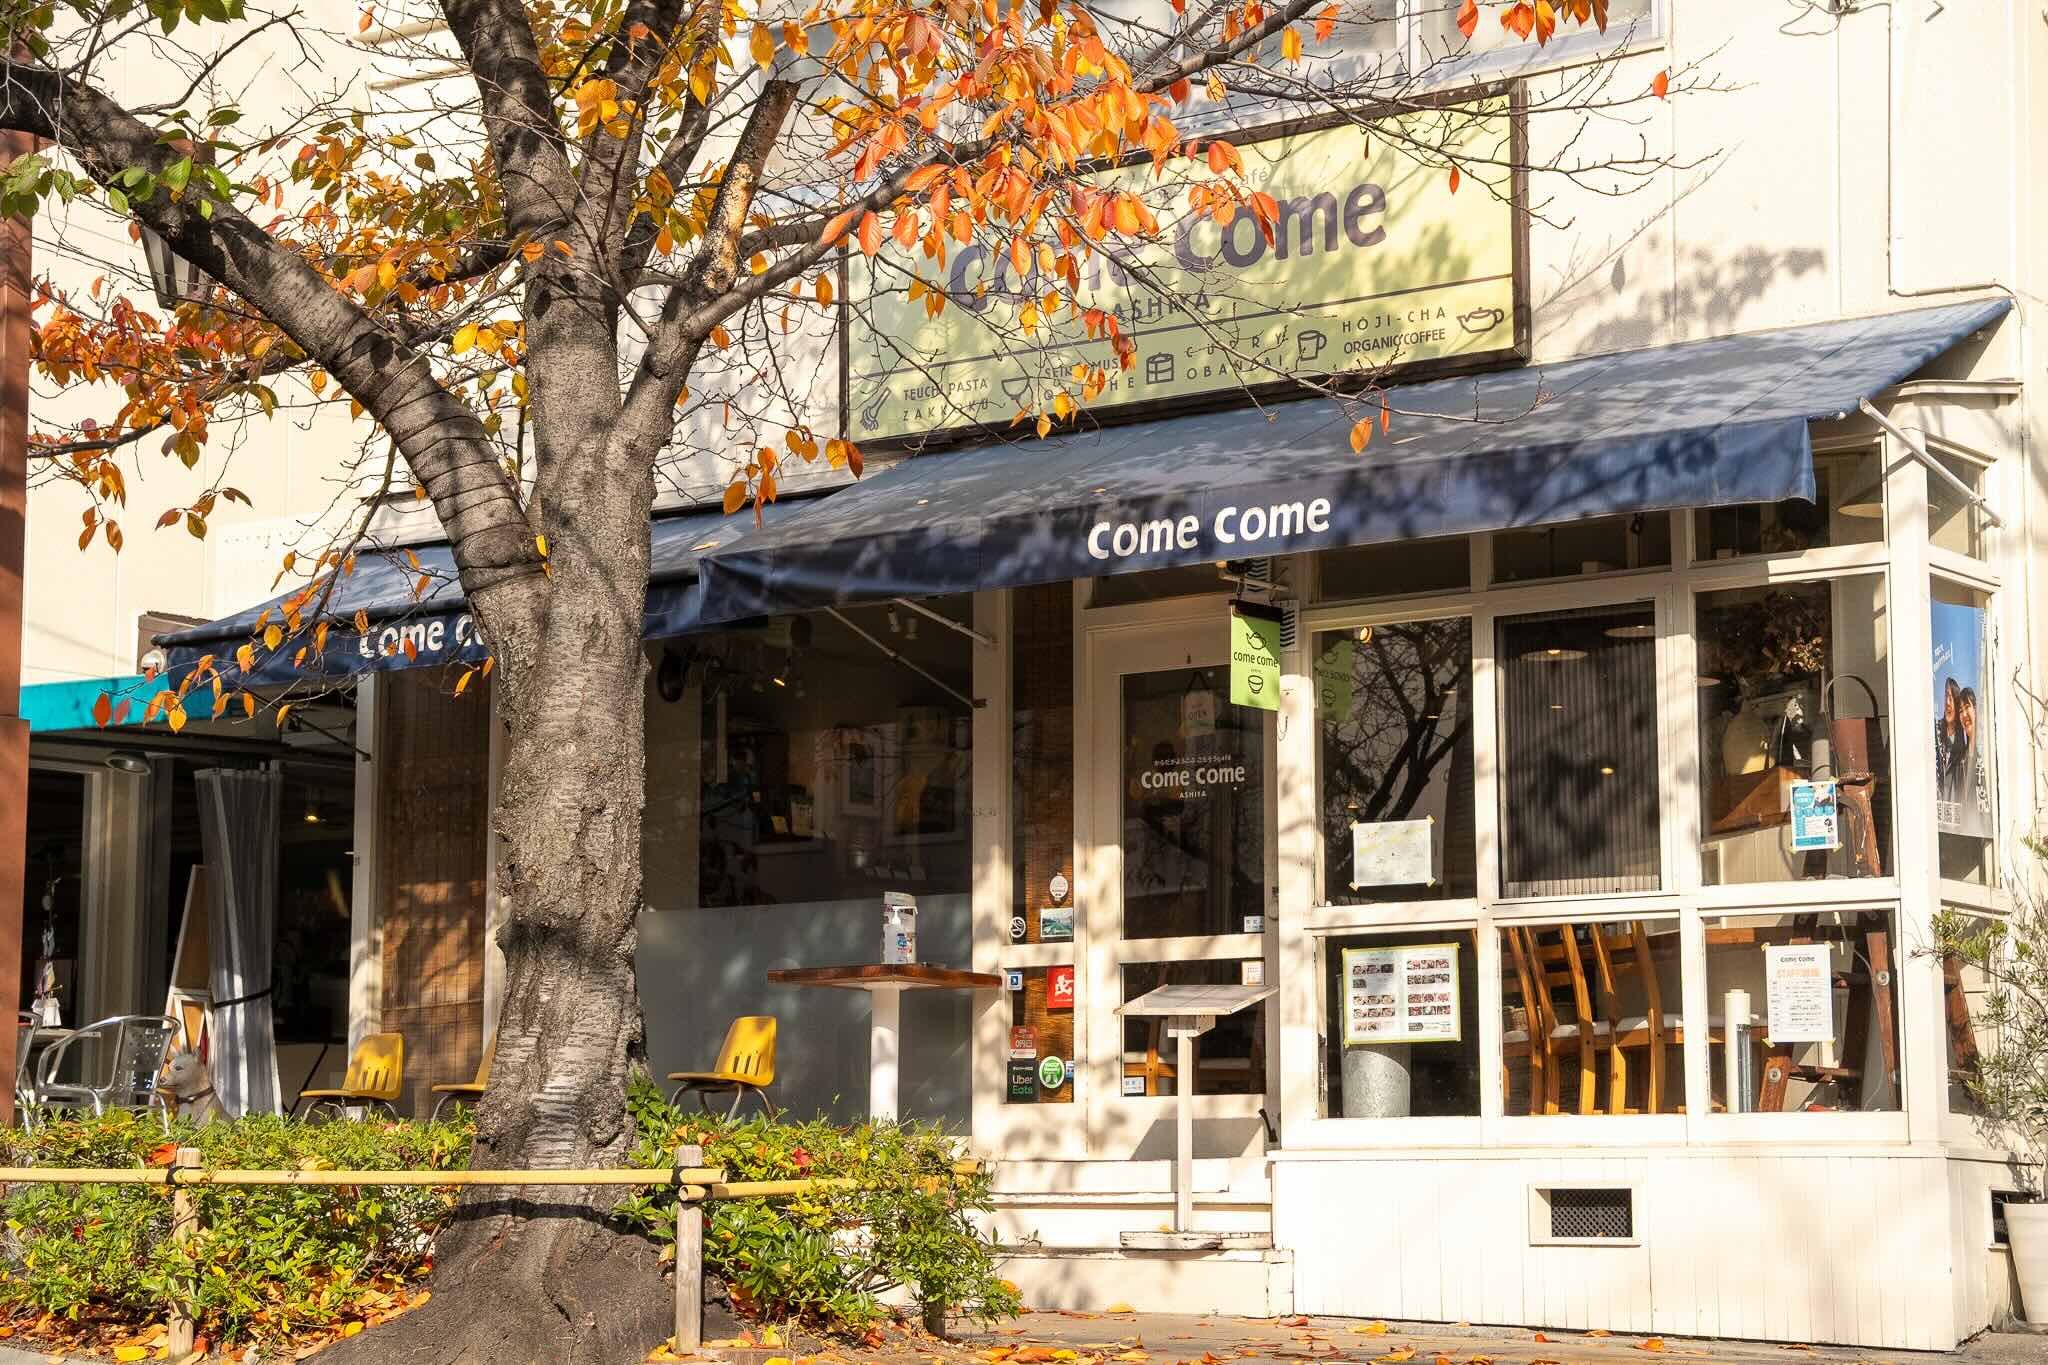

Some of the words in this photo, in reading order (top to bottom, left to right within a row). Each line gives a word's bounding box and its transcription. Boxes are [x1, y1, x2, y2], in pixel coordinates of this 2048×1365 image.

[1343, 335, 1402, 354] ORGANIC
[1403, 328, 1446, 345] COFFEE
[949, 378, 988, 394] PASTA
[1088, 515, 1200, 560] come
[1213, 498, 1331, 544] come
[358, 621, 445, 659] come
[1233, 651, 1256, 664] come
[1256, 655, 1279, 668] come
[1141, 770, 1191, 789] come
[1195, 766, 1246, 784] come
[1179, 790, 1207, 799] ASHITA
[1012, 1075, 1033, 1085] Uber
